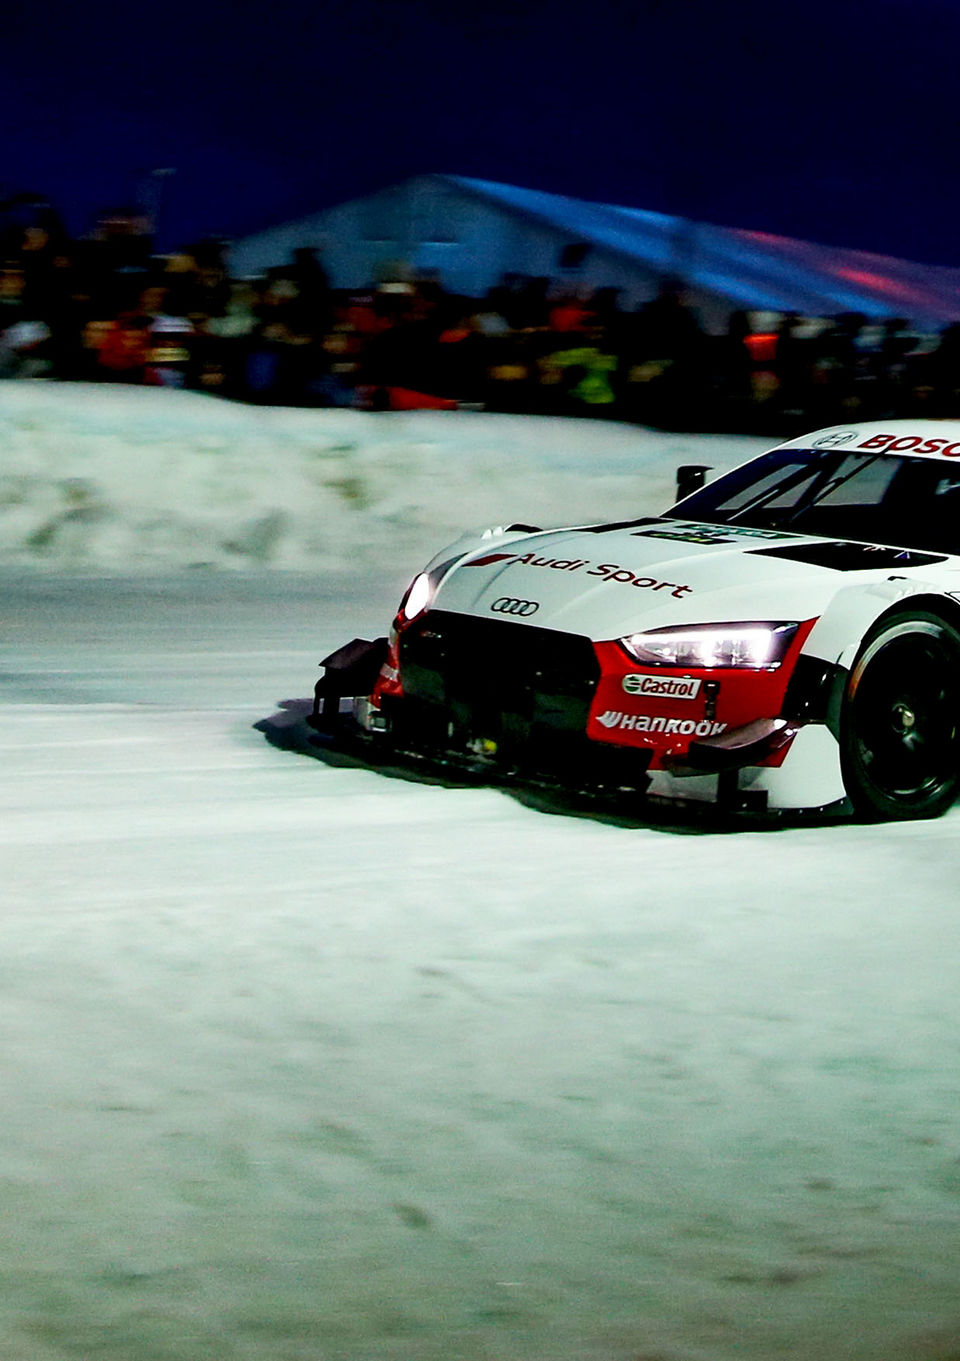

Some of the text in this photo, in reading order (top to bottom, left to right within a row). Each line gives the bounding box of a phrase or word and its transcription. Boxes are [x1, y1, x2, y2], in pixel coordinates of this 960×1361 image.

[506, 553, 693, 599] Audi Sport
[641, 677, 695, 697] Castrol
